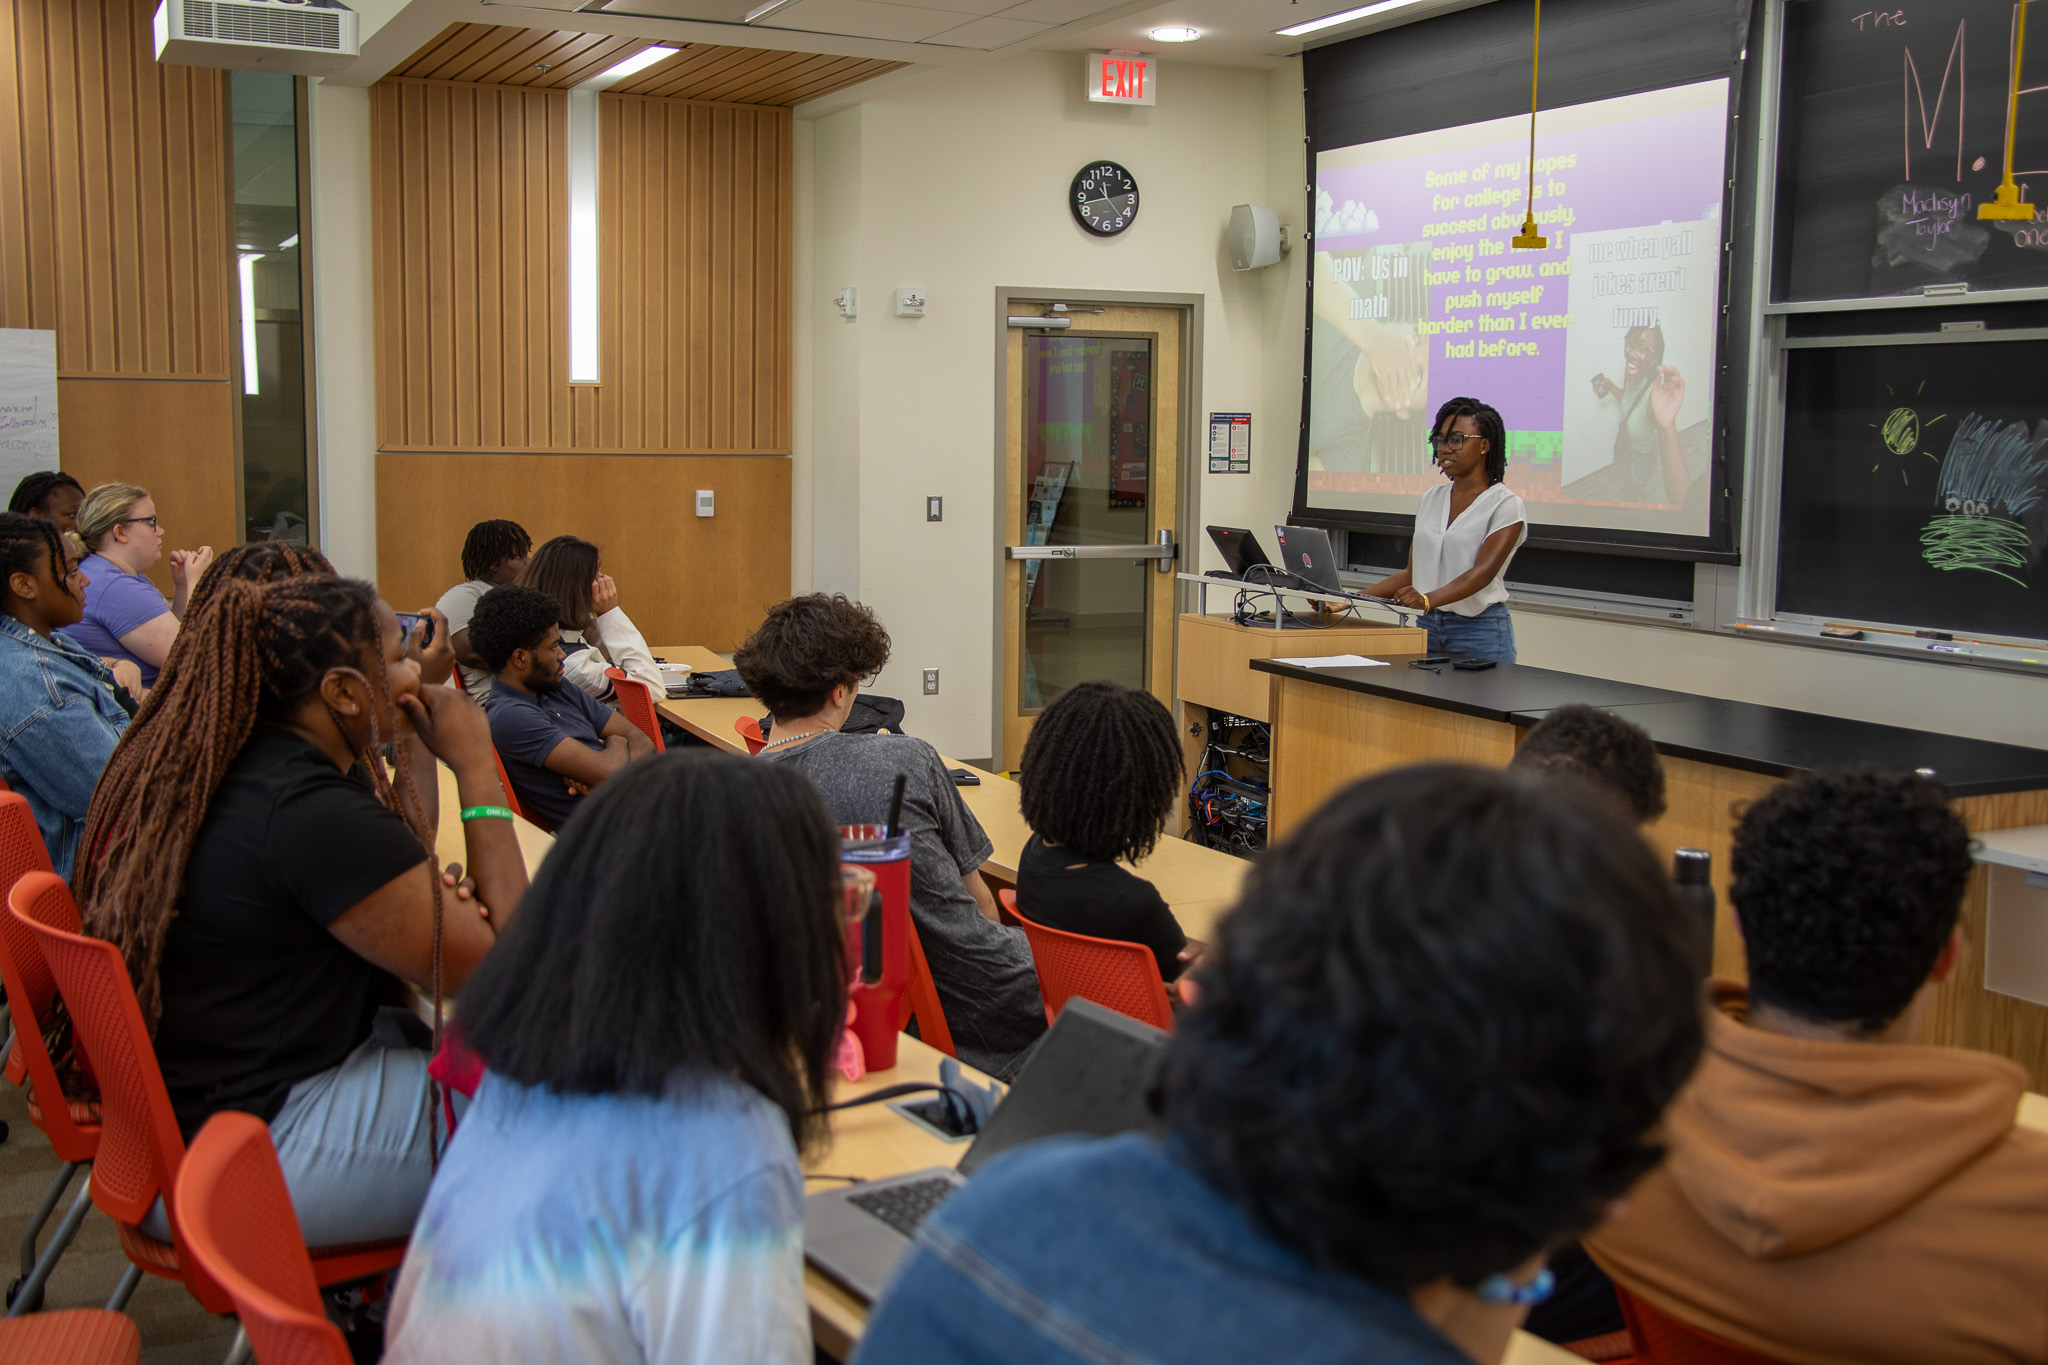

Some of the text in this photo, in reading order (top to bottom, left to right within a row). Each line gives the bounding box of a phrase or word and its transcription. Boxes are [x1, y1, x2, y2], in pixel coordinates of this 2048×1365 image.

[1102, 58, 1147, 99] EXIT
[1090, 170, 1100, 180] 11
[1100, 166, 1113, 176] 12
[1116, 170, 1121, 180] 1
[1425, 153, 1577, 189] Some of my hopes
[1082, 180, 1094, 190] 10
[1123, 179, 1132, 190] 2
[1433, 194, 1460, 212] for
[1464, 187, 1522, 208] college
[1547, 178, 1566, 197] to
[1078, 192, 1086, 203] 9
[1127, 194, 1135, 205] 3
[1082, 205, 1091, 217] 8
[1092, 216, 1100, 226] 7
[1115, 217, 1123, 227] 5
[1122, 207, 1132, 217] 4
[1102, 220, 1111, 231] 6
[1422, 213, 1487, 238] succeed
[1905, 217, 1954, 251] Taylor
[1432, 242, 1474, 264] enjoy
[1478, 238, 1505, 257] the
[1554, 230, 1564, 249] I
[1589, 230, 1693, 263] me when yall
[1333, 253, 1408, 284] POV: Us in
[1423, 256, 1572, 286] have to grow, and
[1592, 266, 1686, 299] jokes aren't
[1349, 292, 1388, 320] math
[1445, 285, 1544, 314] push myself
[1418, 312, 1575, 335] harder than I ever
[1612, 304, 1661, 329] funny.
[1445, 339, 1540, 359] had before.
